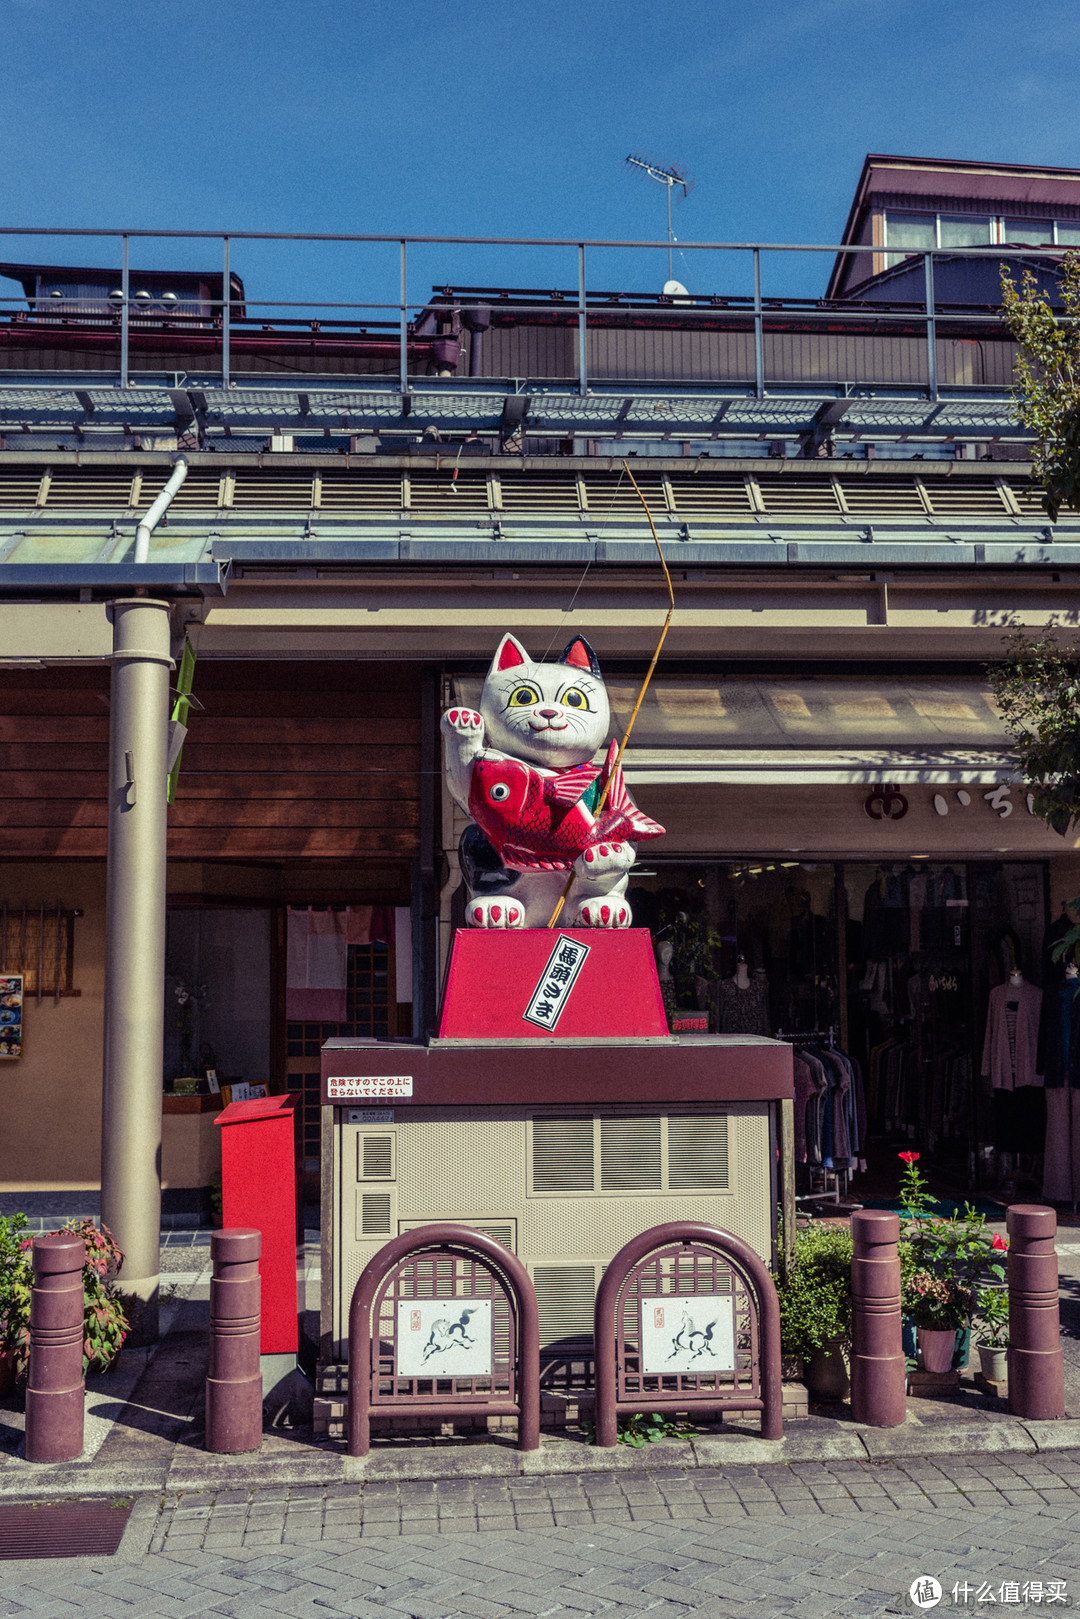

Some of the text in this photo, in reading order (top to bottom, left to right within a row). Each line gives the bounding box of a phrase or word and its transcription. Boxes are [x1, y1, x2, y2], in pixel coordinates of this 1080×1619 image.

[330, 1078, 410, 1087] 危険ですのでこの上に
[330, 1088, 406, 1097] 登らないでください。
